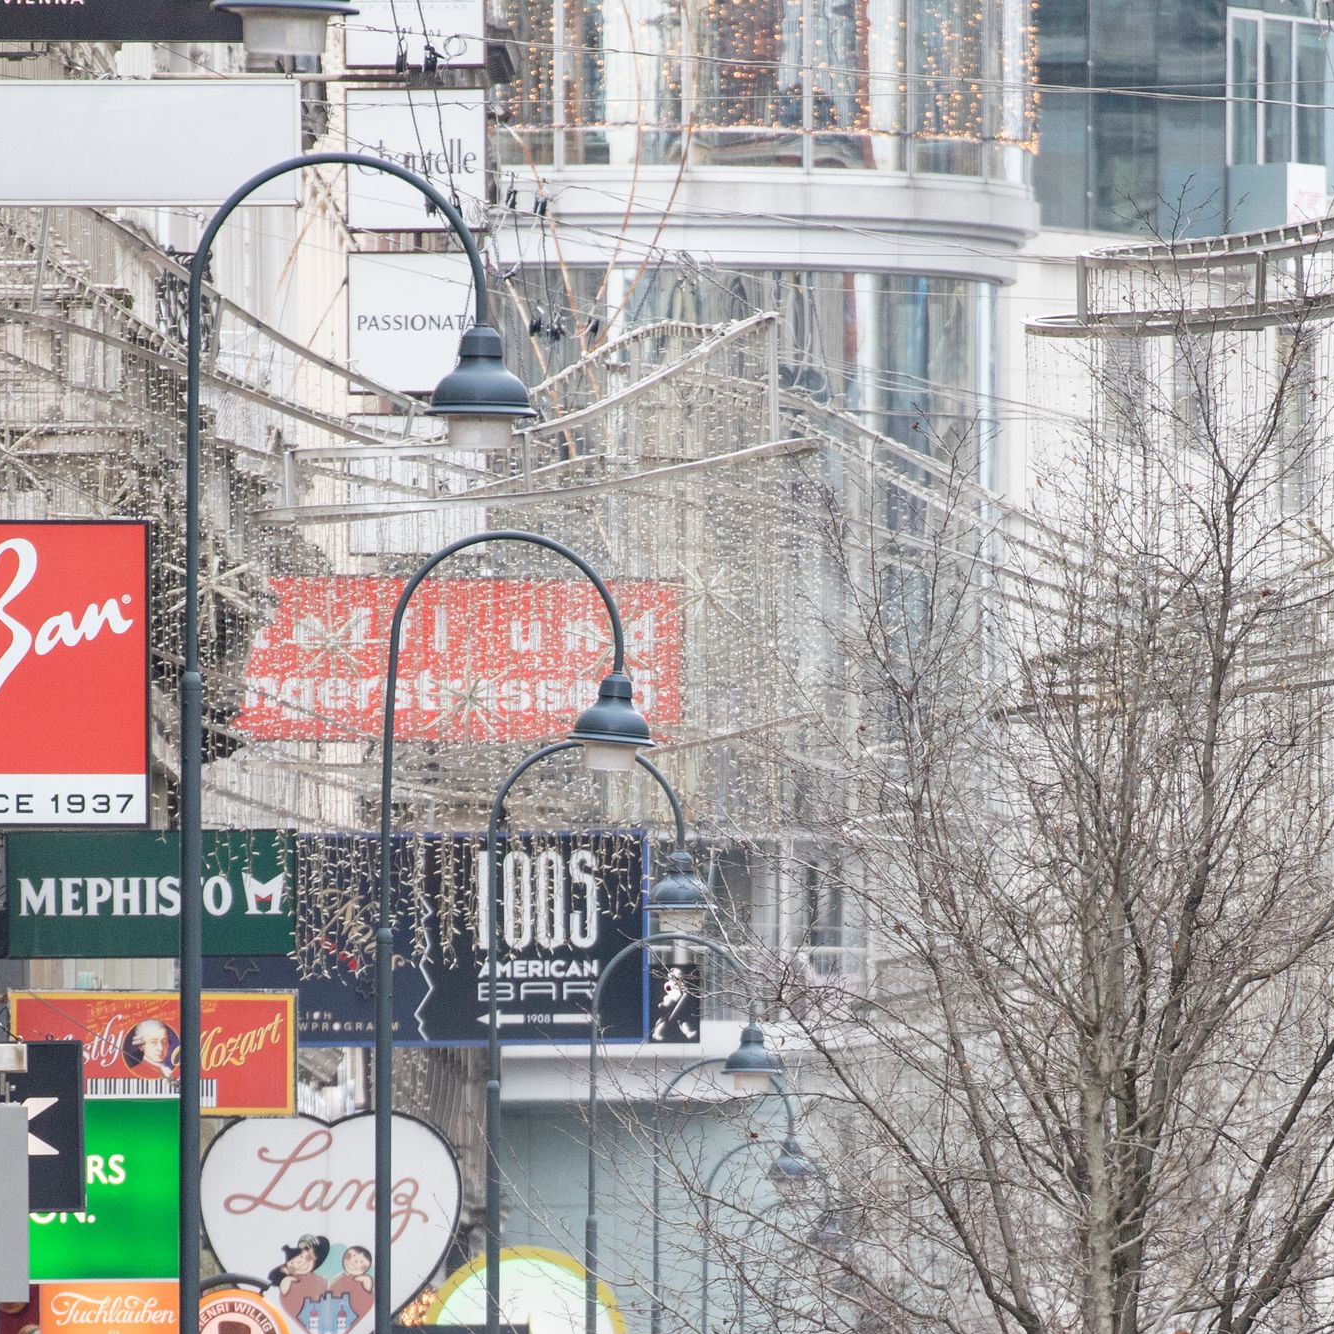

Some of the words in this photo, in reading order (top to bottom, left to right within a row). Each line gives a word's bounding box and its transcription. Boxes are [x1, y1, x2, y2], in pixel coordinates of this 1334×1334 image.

[50, 793, 134, 814] 1937
[17, 876, 233, 917] MEPHISO
[526, 1013, 552, 1025] 1908
[50, 1291, 176, 1326] Tuchlauben
[233, 1302, 272, 1333] WILLIG
